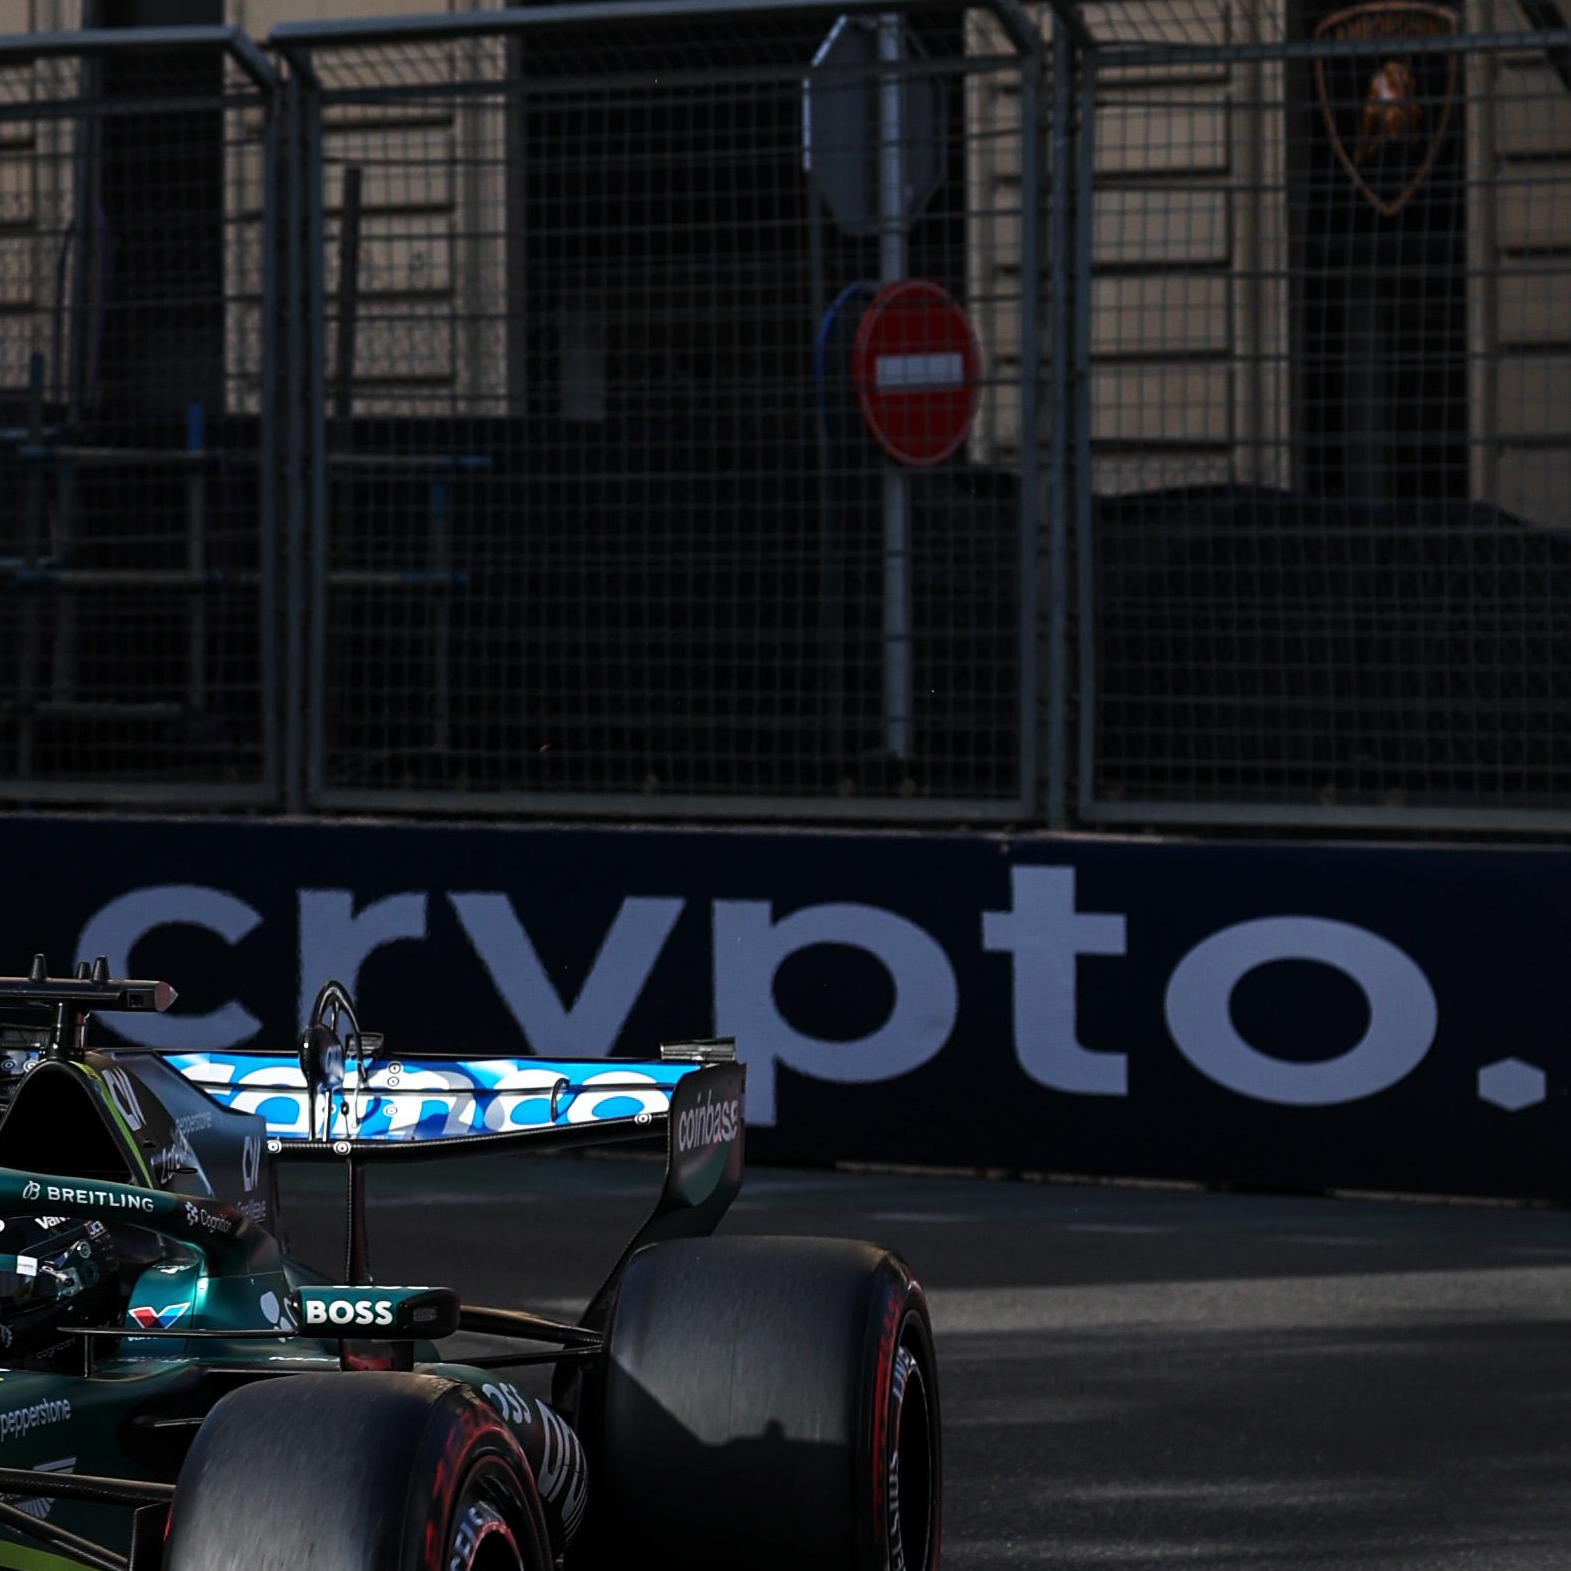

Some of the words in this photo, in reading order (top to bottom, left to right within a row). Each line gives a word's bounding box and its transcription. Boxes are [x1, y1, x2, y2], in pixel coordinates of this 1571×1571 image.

[46, 1184, 156, 1215] BREITLING
[305, 1299, 394, 1326] BOSS
[0, 1397, 72, 1444] pepperstone
[481, 1381, 533, 1425] OSS
